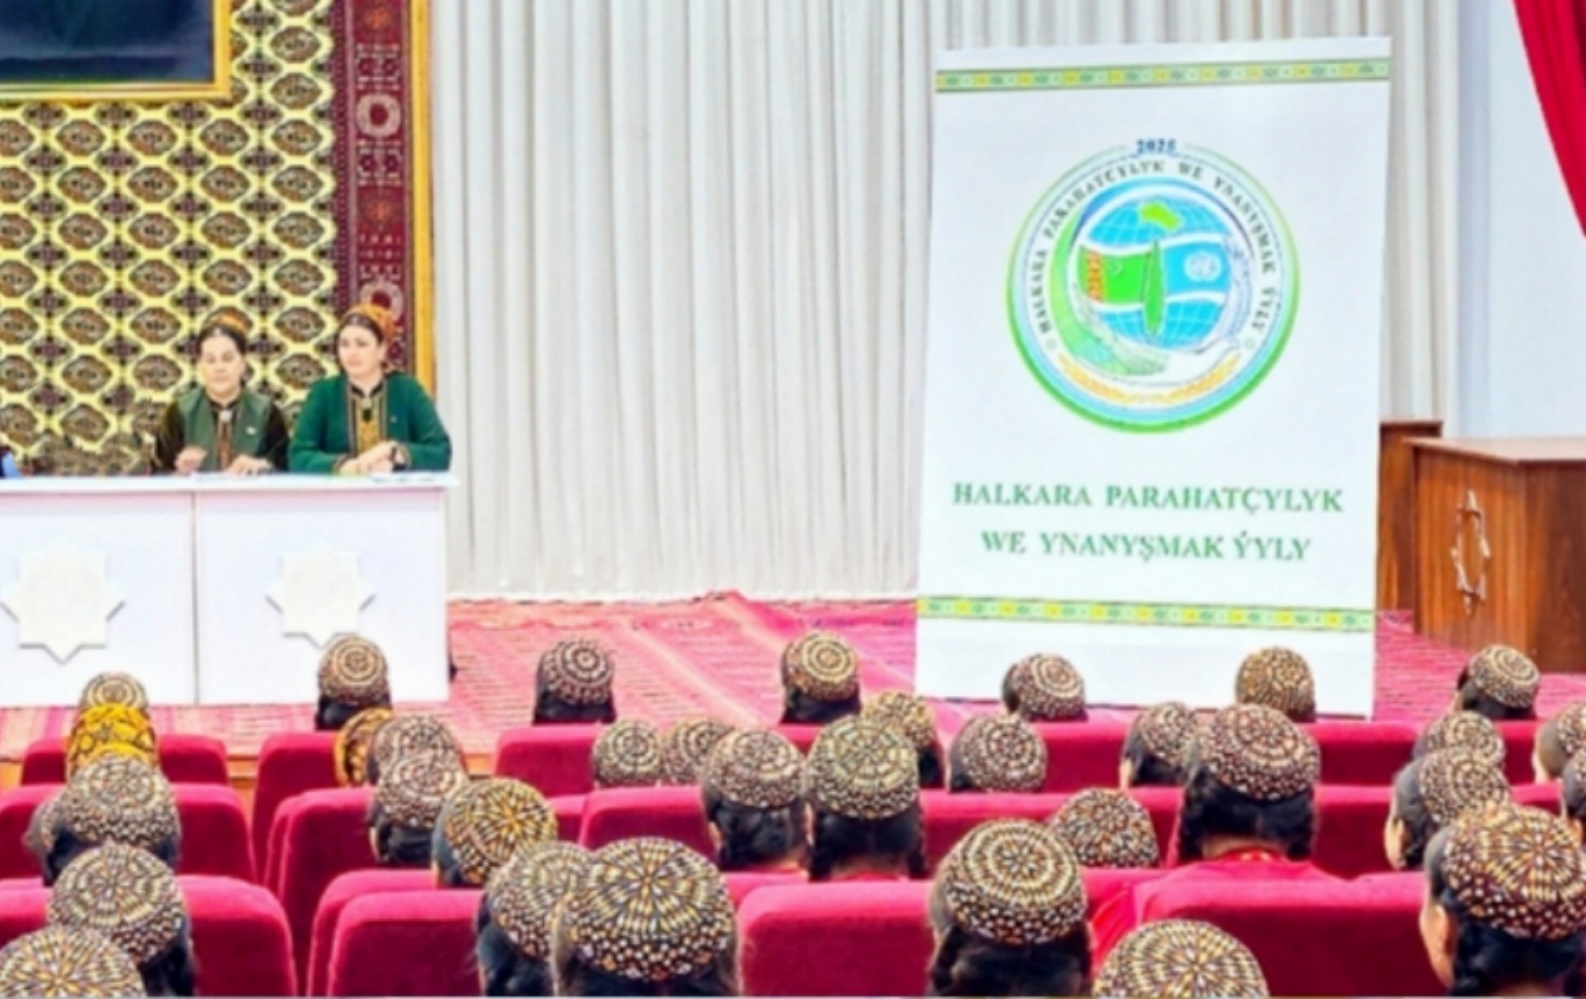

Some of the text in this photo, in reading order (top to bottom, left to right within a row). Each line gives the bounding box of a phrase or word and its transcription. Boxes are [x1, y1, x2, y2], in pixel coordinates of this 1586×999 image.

[1136, 138, 1176, 153] 2025
[1179, 162, 1204, 180] WE
[953, 483, 1343, 515] HALKARA PARAHATÇYLYK
[981, 530, 1311, 562] WE YNANYŞMAK ÝYLY
